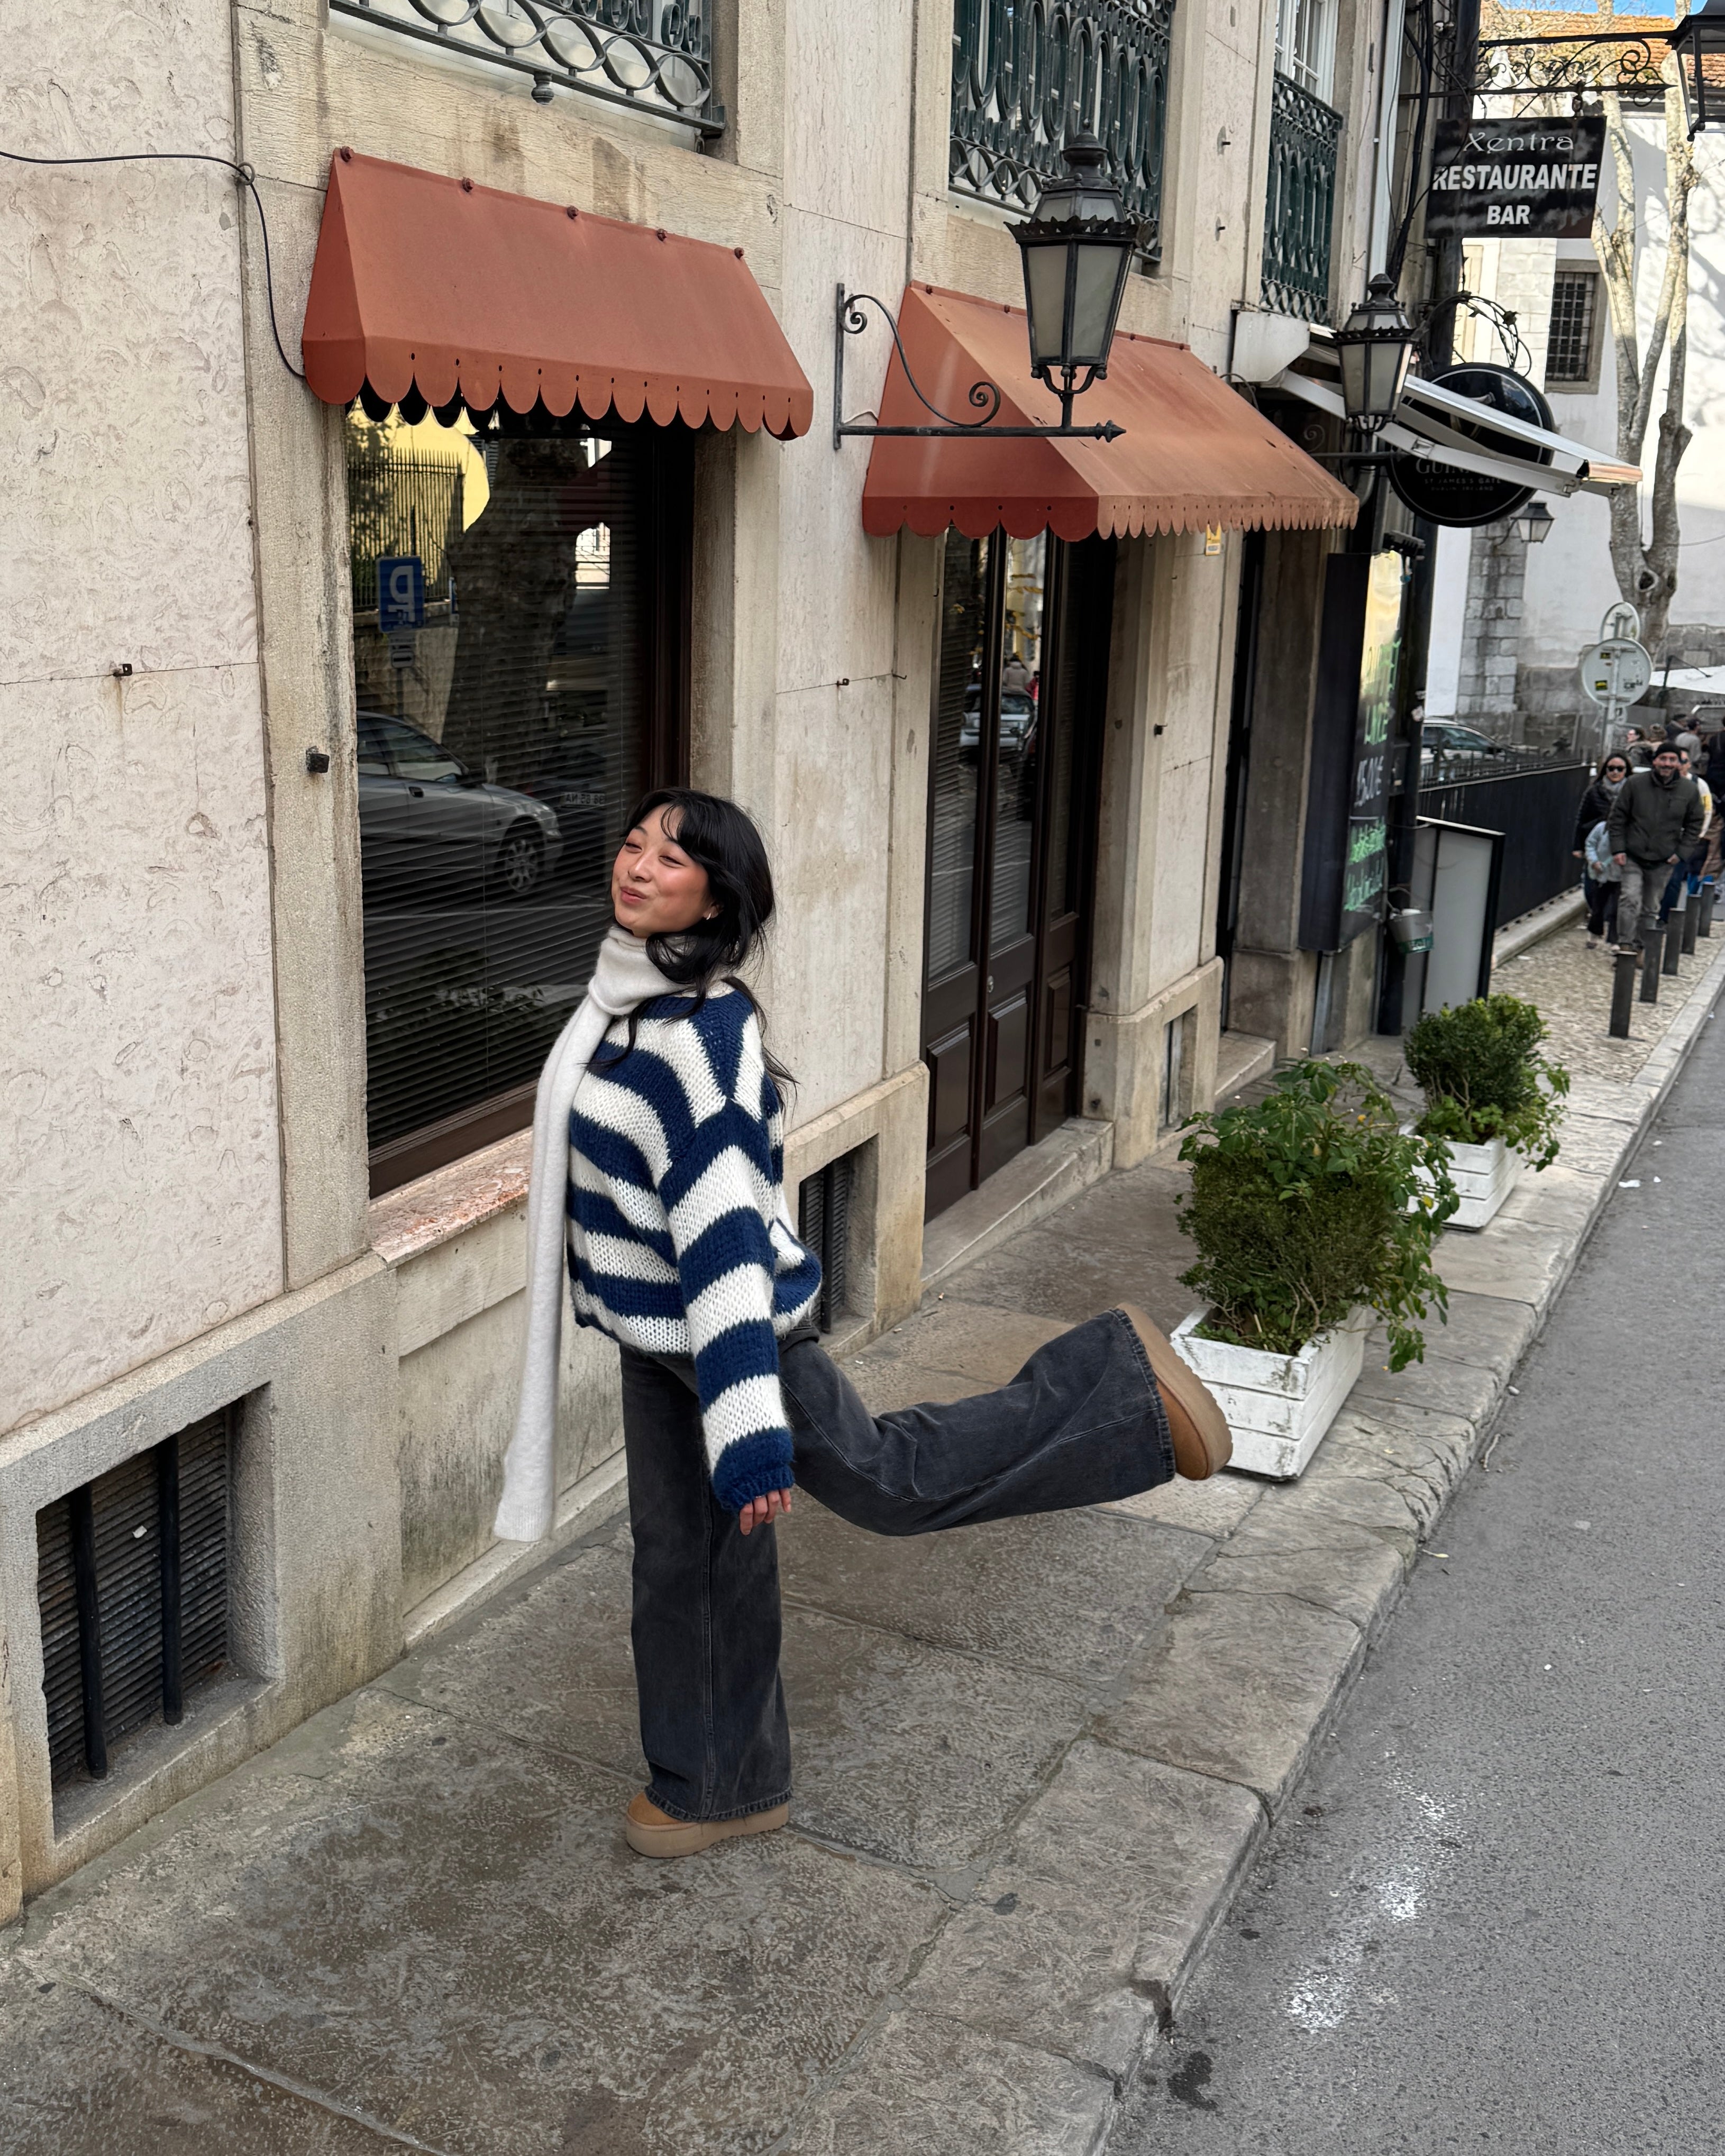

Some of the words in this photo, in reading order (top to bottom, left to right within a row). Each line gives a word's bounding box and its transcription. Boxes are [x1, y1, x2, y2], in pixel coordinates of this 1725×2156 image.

[1463, 132, 1574, 154] Xentra
[1432, 163, 1598, 190] RESTAURANTE
[1487, 205, 1530, 225] BAR
